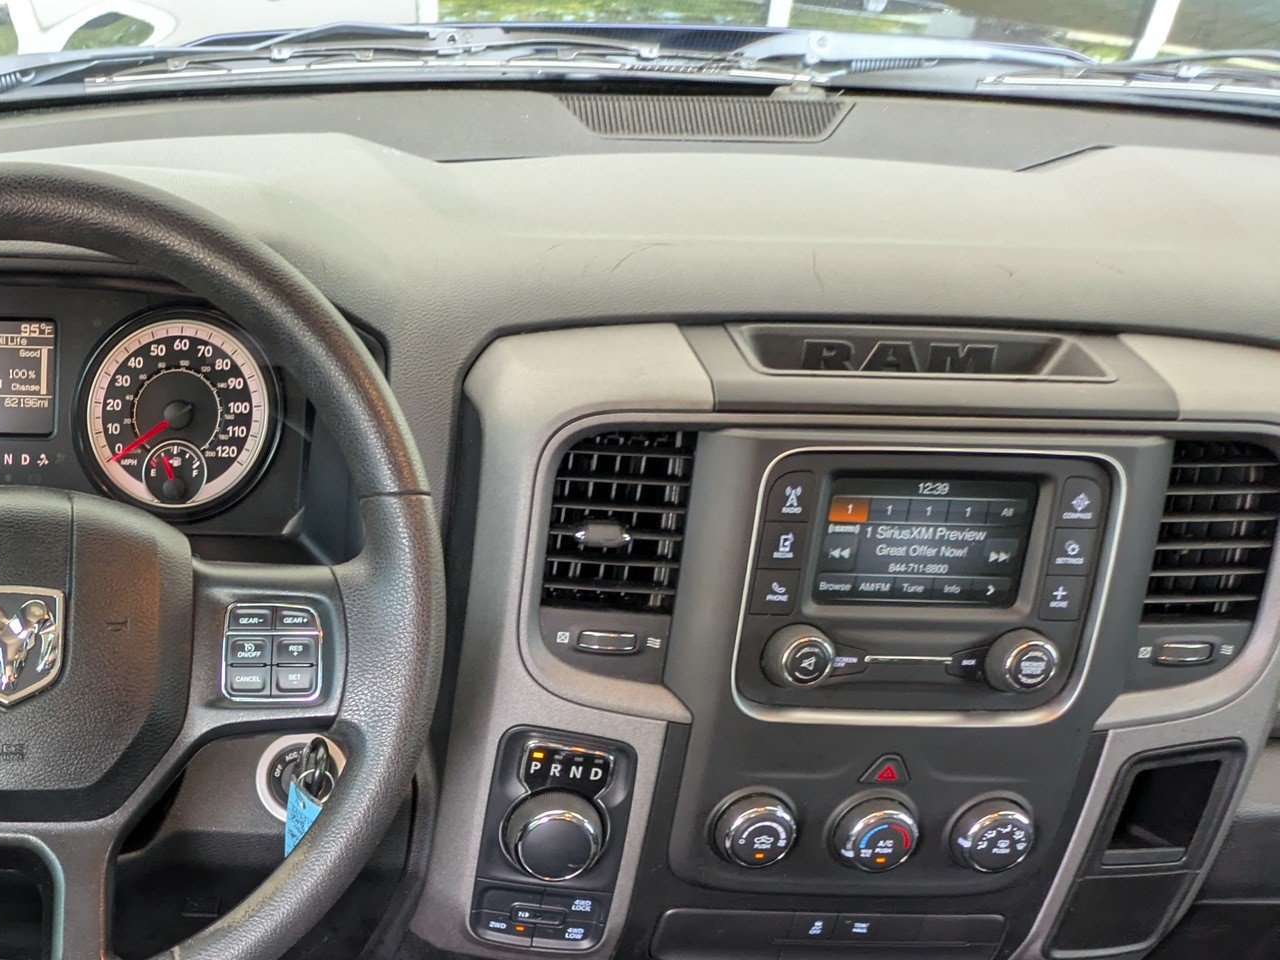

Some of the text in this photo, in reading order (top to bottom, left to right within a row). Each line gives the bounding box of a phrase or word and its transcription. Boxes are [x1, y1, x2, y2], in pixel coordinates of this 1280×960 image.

[8, 336, 28, 346] Life
[174, 339, 190, 351] 60
[150, 344, 166, 356] 50
[197, 346, 213, 357] 70
[801, 339, 999, 372] RAM
[128, 357, 143, 368] 40
[215, 359, 231, 370] 80
[115, 375, 131, 387] 30
[227, 378, 244, 389] 90
[11, 383, 40, 391] Change
[106, 399, 122, 411] 20
[228, 402, 250, 414] 100
[107, 423, 120, 434] 10
[227, 426, 247, 437] 110
[115, 443, 123, 454] 0
[216, 446, 237, 457] 120
[4, 454, 13, 465] N
[21, 454, 30, 465] D
[847, 504, 853, 514] 1
[887, 505, 893, 515] 1
[926, 506, 933, 516] 1
[965, 507, 972, 517] 1
[866, 526, 873, 538] 1
[876, 525, 934, 540] SiriusXM
[935, 527, 987, 541] Preview
[875, 544, 969, 557] Great Offer Now!
[819, 581, 960, 593] Browse AM/FM Tune Info
[285, 751, 298, 761] ACC
[274, 764, 283, 778] OFF
[530, 761, 602, 780] P R N D
[489, 921, 506, 929] 2WD
